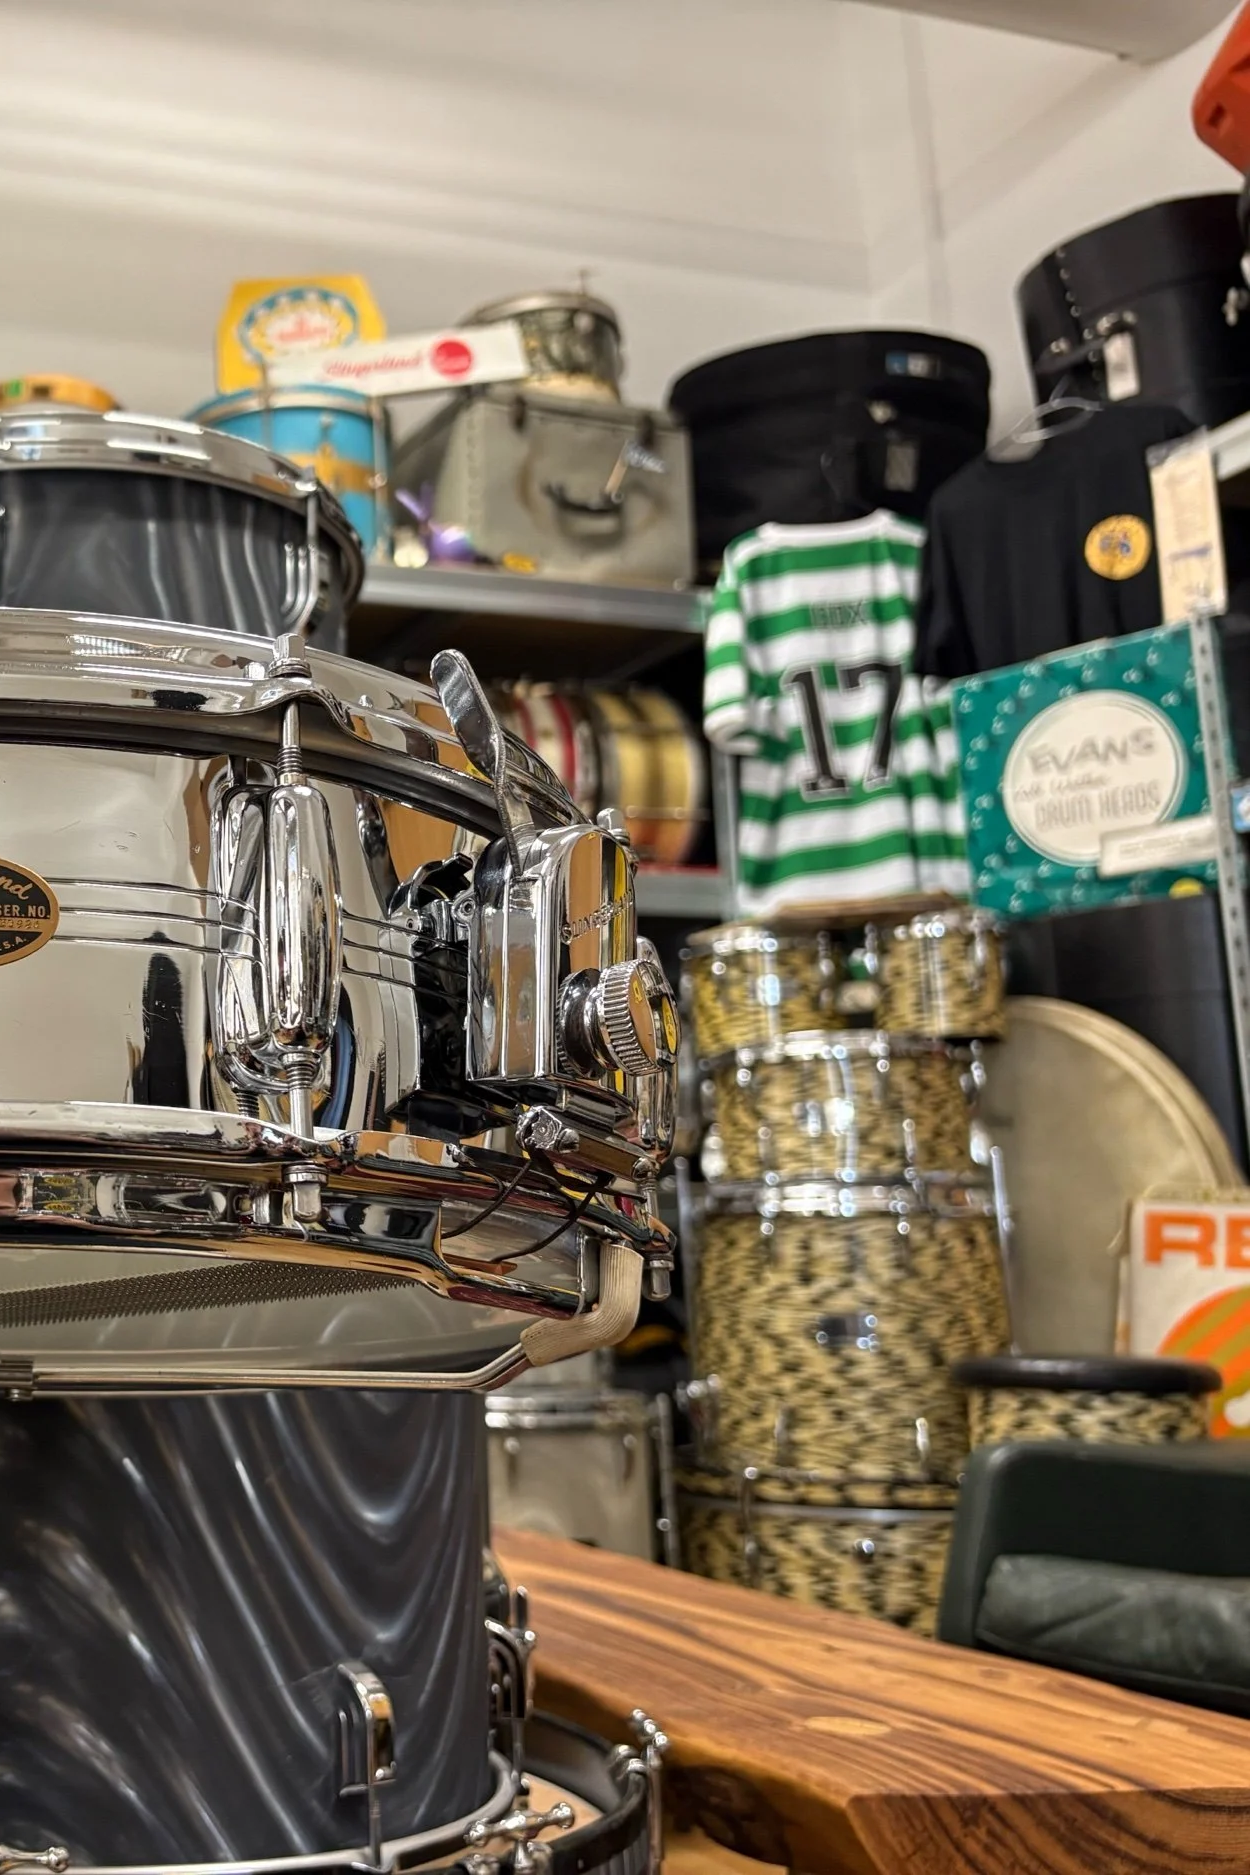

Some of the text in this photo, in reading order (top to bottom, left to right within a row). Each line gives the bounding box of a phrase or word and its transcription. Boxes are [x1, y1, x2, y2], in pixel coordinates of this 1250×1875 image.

[784, 660, 902, 801] 17
[1027, 726, 1156, 775] EVANS
[1034, 779, 1161, 832] DRUM HEADS
